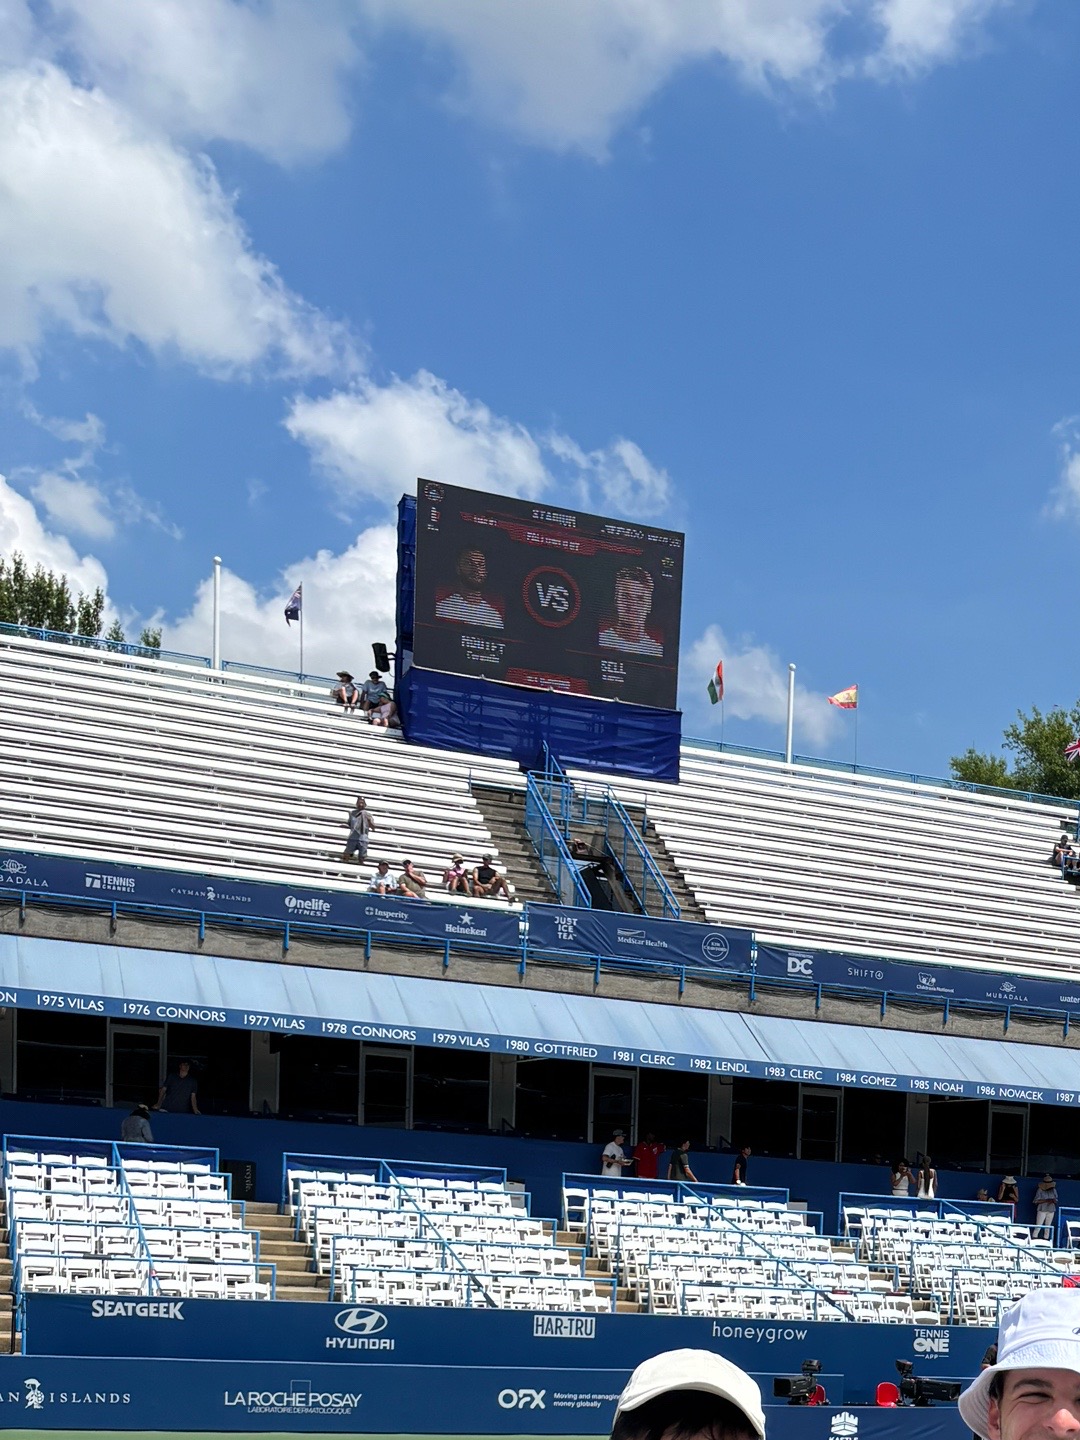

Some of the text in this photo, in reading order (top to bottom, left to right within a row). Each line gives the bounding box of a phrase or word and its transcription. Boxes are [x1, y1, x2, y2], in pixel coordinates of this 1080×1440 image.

[536, 582, 569, 613] VS
[102, 875, 136, 887] TENNIS
[102, 885, 135, 893] CHANNEL
[171, 887, 252, 903] CAYMAN ISLANDS
[288, 908, 328, 918] FITNESS
[374, 908, 409, 920] Insperity
[554, 916, 578, 926] JUST
[445, 923, 488, 937] Heineken
[558, 925, 574, 933] ICE
[617, 936, 668, 948] MedStar Health
[787, 957, 814, 975] DC
[37, 994, 104, 1012] 1975 VILAS
[986, 991, 1029, 1002] MUBADALA
[123, 1002, 226, 1022] 1976 CONNORS
[243, 1014, 306, 1030] 1977 VILAS
[321, 1022, 417, 1041] 1978 CONNORS
[432, 1032, 490, 1048] 1979 VILAS
[505, 1039, 598, 1058] 1980 GOTTFRIED
[613, 1050, 676, 1066] 1981 CLERC
[690, 1058, 750, 1074] 1982 LENDL
[764, 1066, 823, 1081] 1983 CLERC
[836, 1072, 897, 1087] 1984 GOMEZ
[910, 1079, 964, 1093] 1985 NOAH
[976, 1085, 1044, 1101] 1986 NOVACEK
[1056, 1092, 1075, 1103] 1987
[91, 1300, 185, 1320] SEATGEEK
[535, 1317, 594, 1337] HAR-TRU
[712, 1321, 808, 1344] honeygrow
[914, 1328, 950, 1339] TENNIS
[326, 1337, 395, 1350] HYUNDAI
[913, 1338, 950, 1353] ONE
[50, 1392, 131, 1404] ISLANDS
[224, 1391, 362, 1408] LA ROCHE POSAY
[498, 1388, 546, 1409] OFX
[553, 1392, 577, 1401] Moving
[575, 1400, 602, 1409] globally
